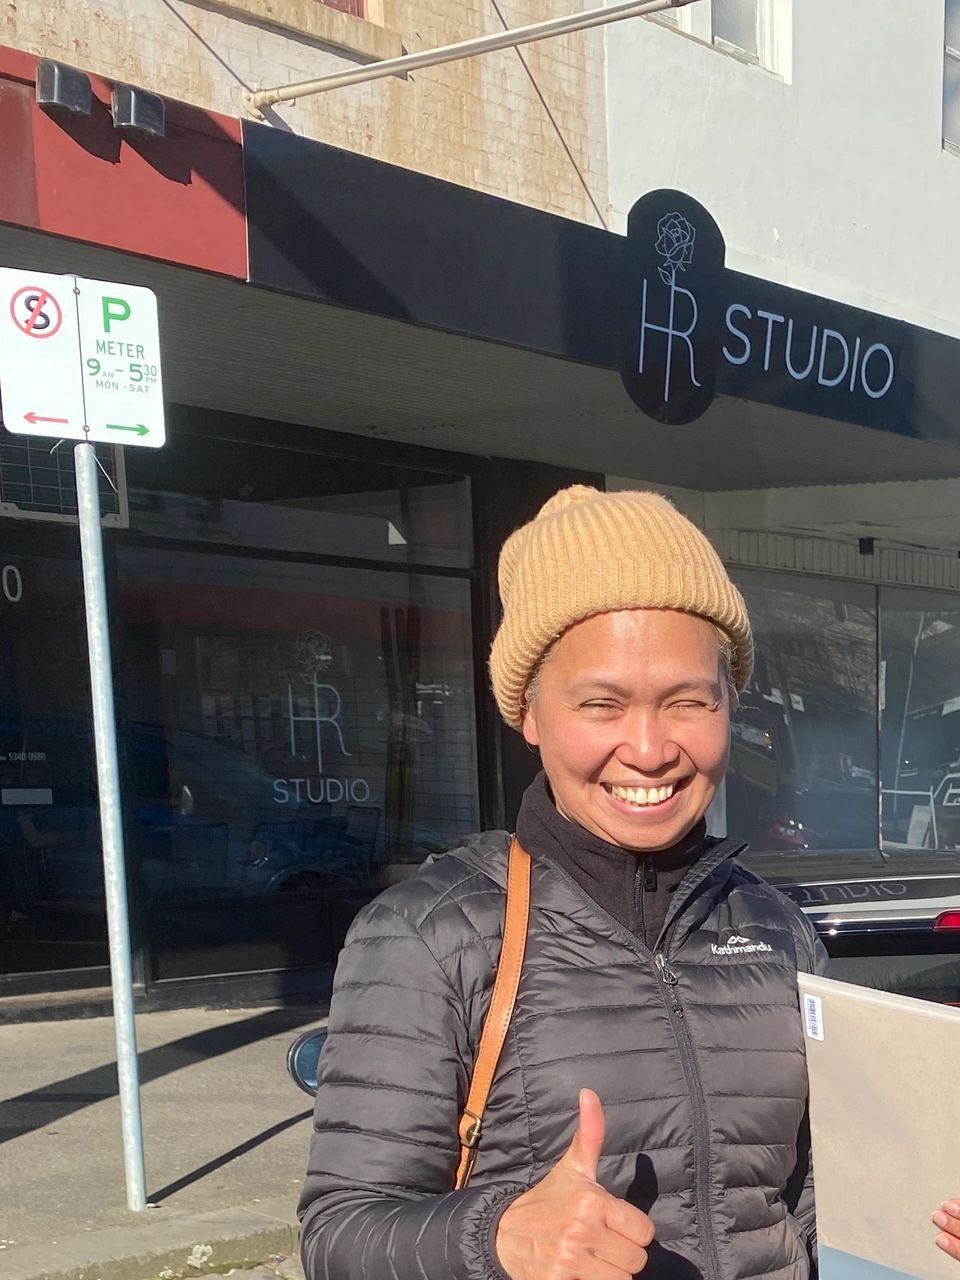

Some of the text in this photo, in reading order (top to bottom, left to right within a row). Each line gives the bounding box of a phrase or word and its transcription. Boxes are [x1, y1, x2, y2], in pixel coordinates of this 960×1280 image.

[101, 295, 131, 333] P
[96, 338, 145, 359] METER
[722, 303, 895, 399] STUDIO
[273, 778, 370, 804] STUDIO
[711, 941, 773, 955] Kathmandu
